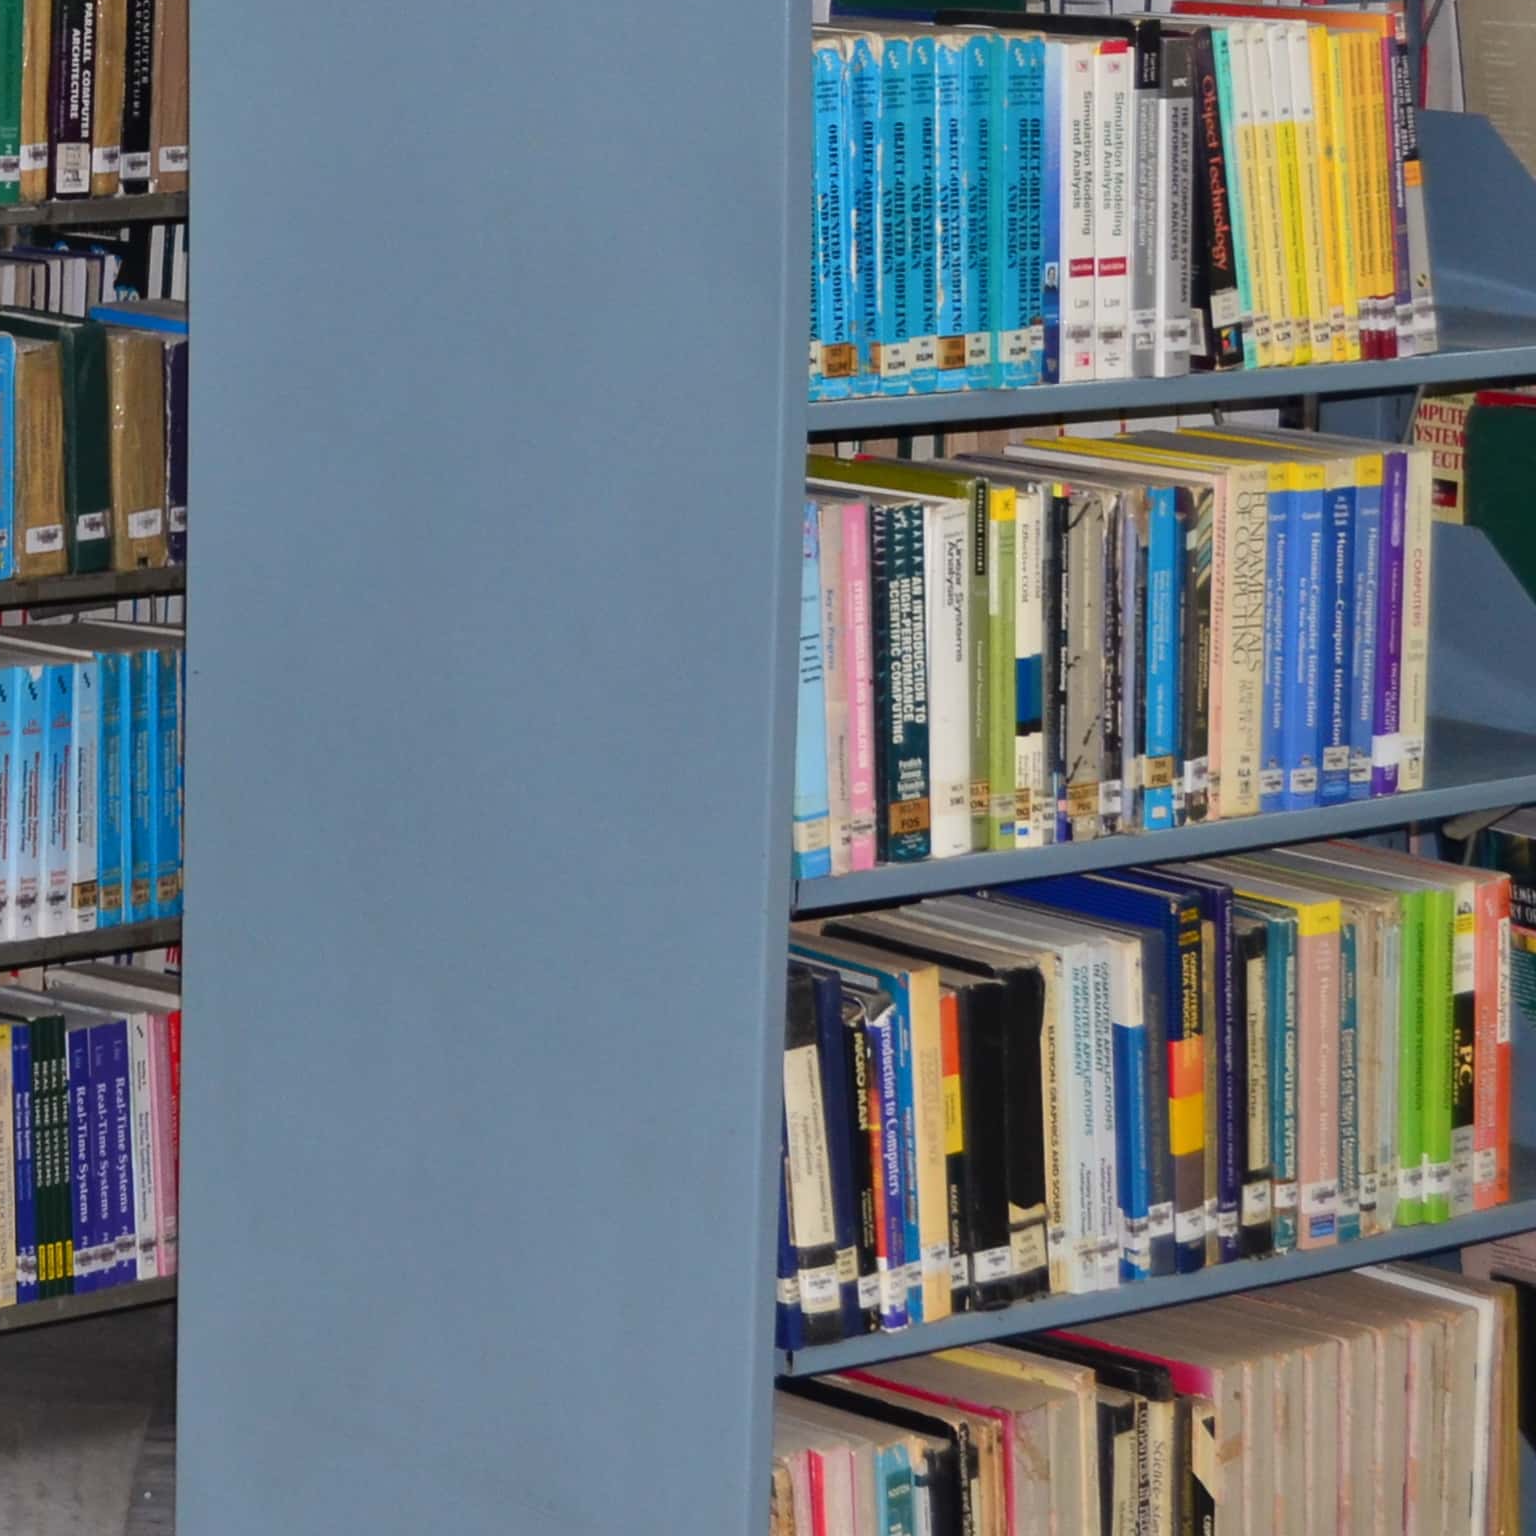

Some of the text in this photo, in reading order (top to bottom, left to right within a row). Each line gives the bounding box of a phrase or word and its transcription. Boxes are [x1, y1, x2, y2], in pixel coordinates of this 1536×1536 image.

[70, 28, 81, 119] ARCHITECTURE
[81, 2, 93, 138] PARALLEL COMPUTER
[1103, 121, 1112, 210] and Analysis
[1112, 92, 1125, 237] Simulation Modeling
[1171, 107, 1179, 195] PERFORMANCE
[1180, 176, 1188, 233] COMPUTER
[1181, 131, 1189, 152] ART
[1202, 75, 1229, 270] Object Technology
[1180, 239, 1188, 303] SYSTEMS
[900, 578, 915, 722] HIGH-PERFORMANCE
[911, 576, 927, 724] AN INTRODUCTION TO
[1232, 524, 1248, 665] COMPUTING
[1246, 490, 1266, 673] FUNDAMENTALS
[889, 580, 904, 744] SCIENTIFIC COMPUTING
